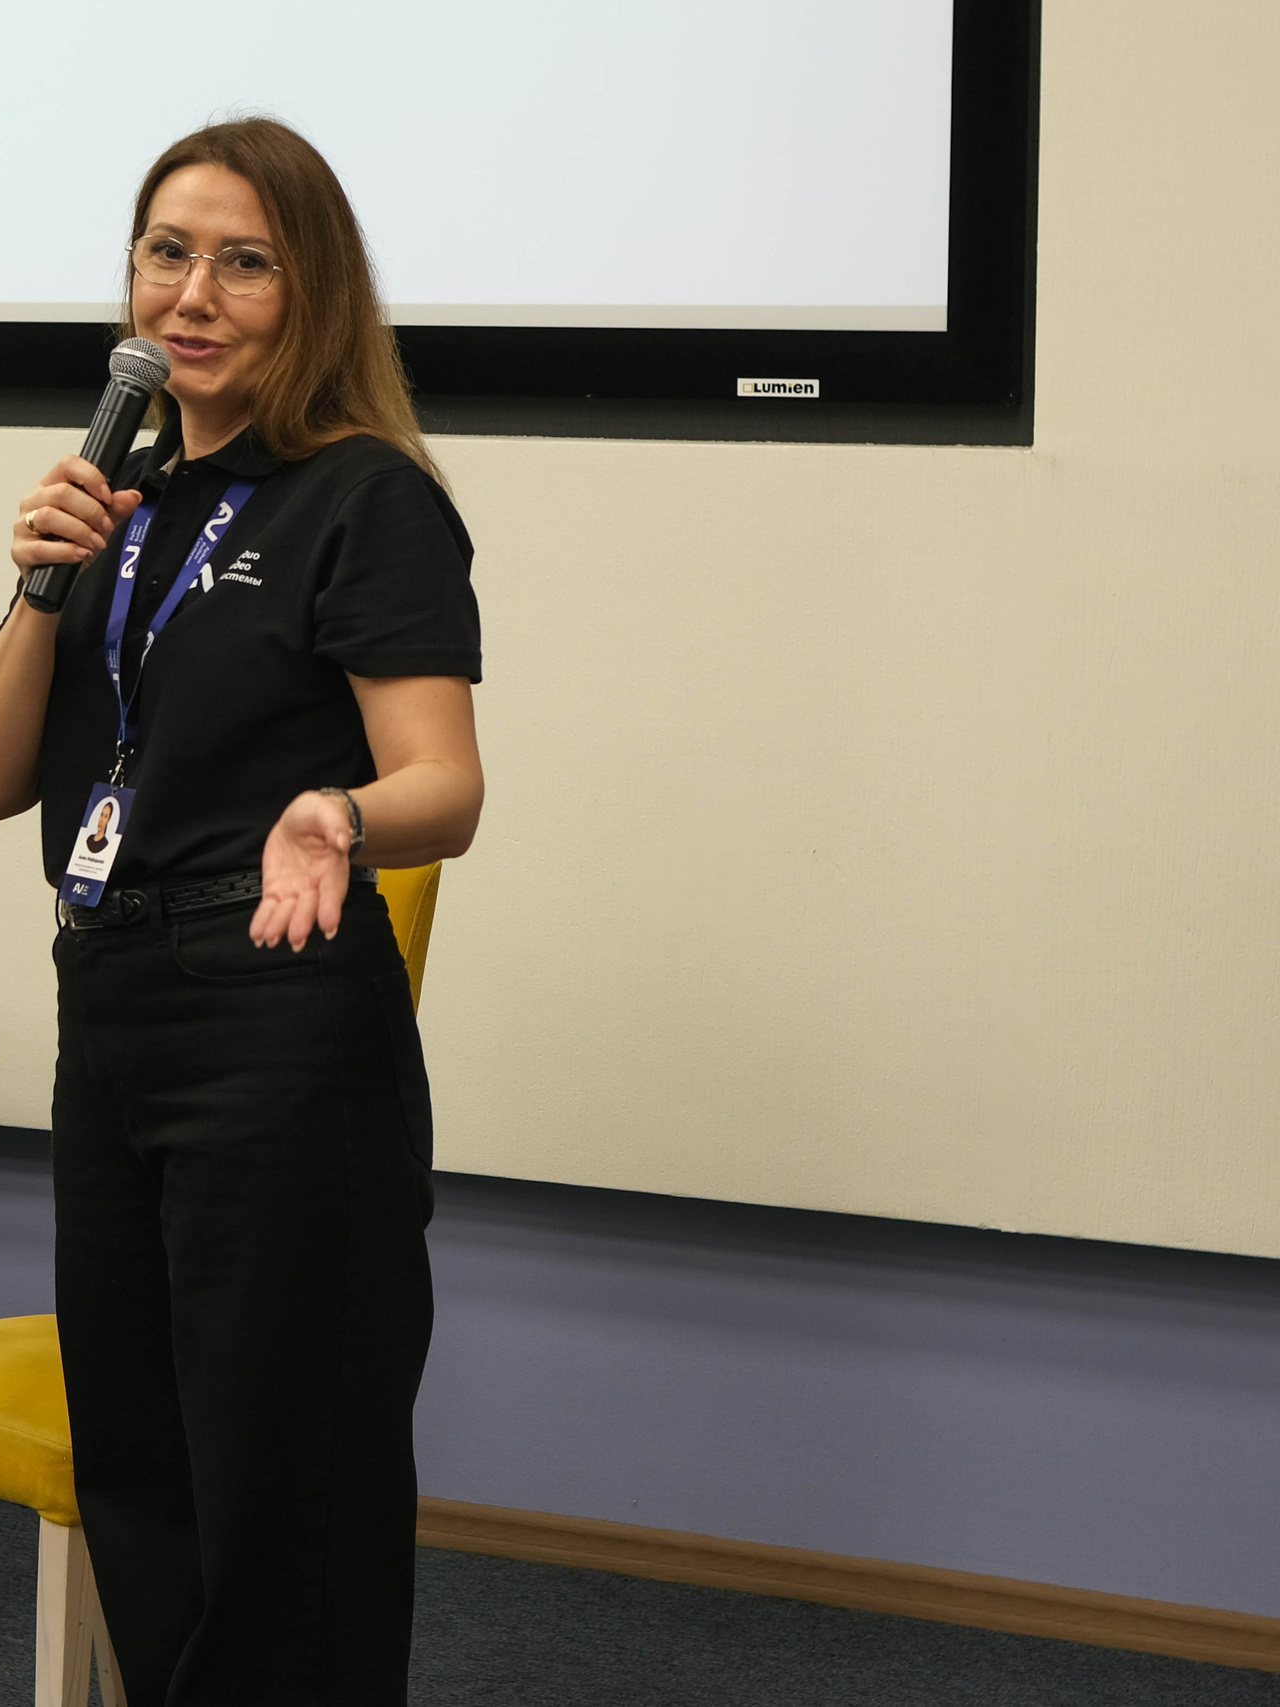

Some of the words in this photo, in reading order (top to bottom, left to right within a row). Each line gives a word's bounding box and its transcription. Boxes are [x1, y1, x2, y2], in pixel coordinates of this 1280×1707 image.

[754, 383, 814, 394] Lumien
[237, 550, 261, 561] дио
[228, 560, 252, 571] део
[219, 572, 263, 587] стемы
